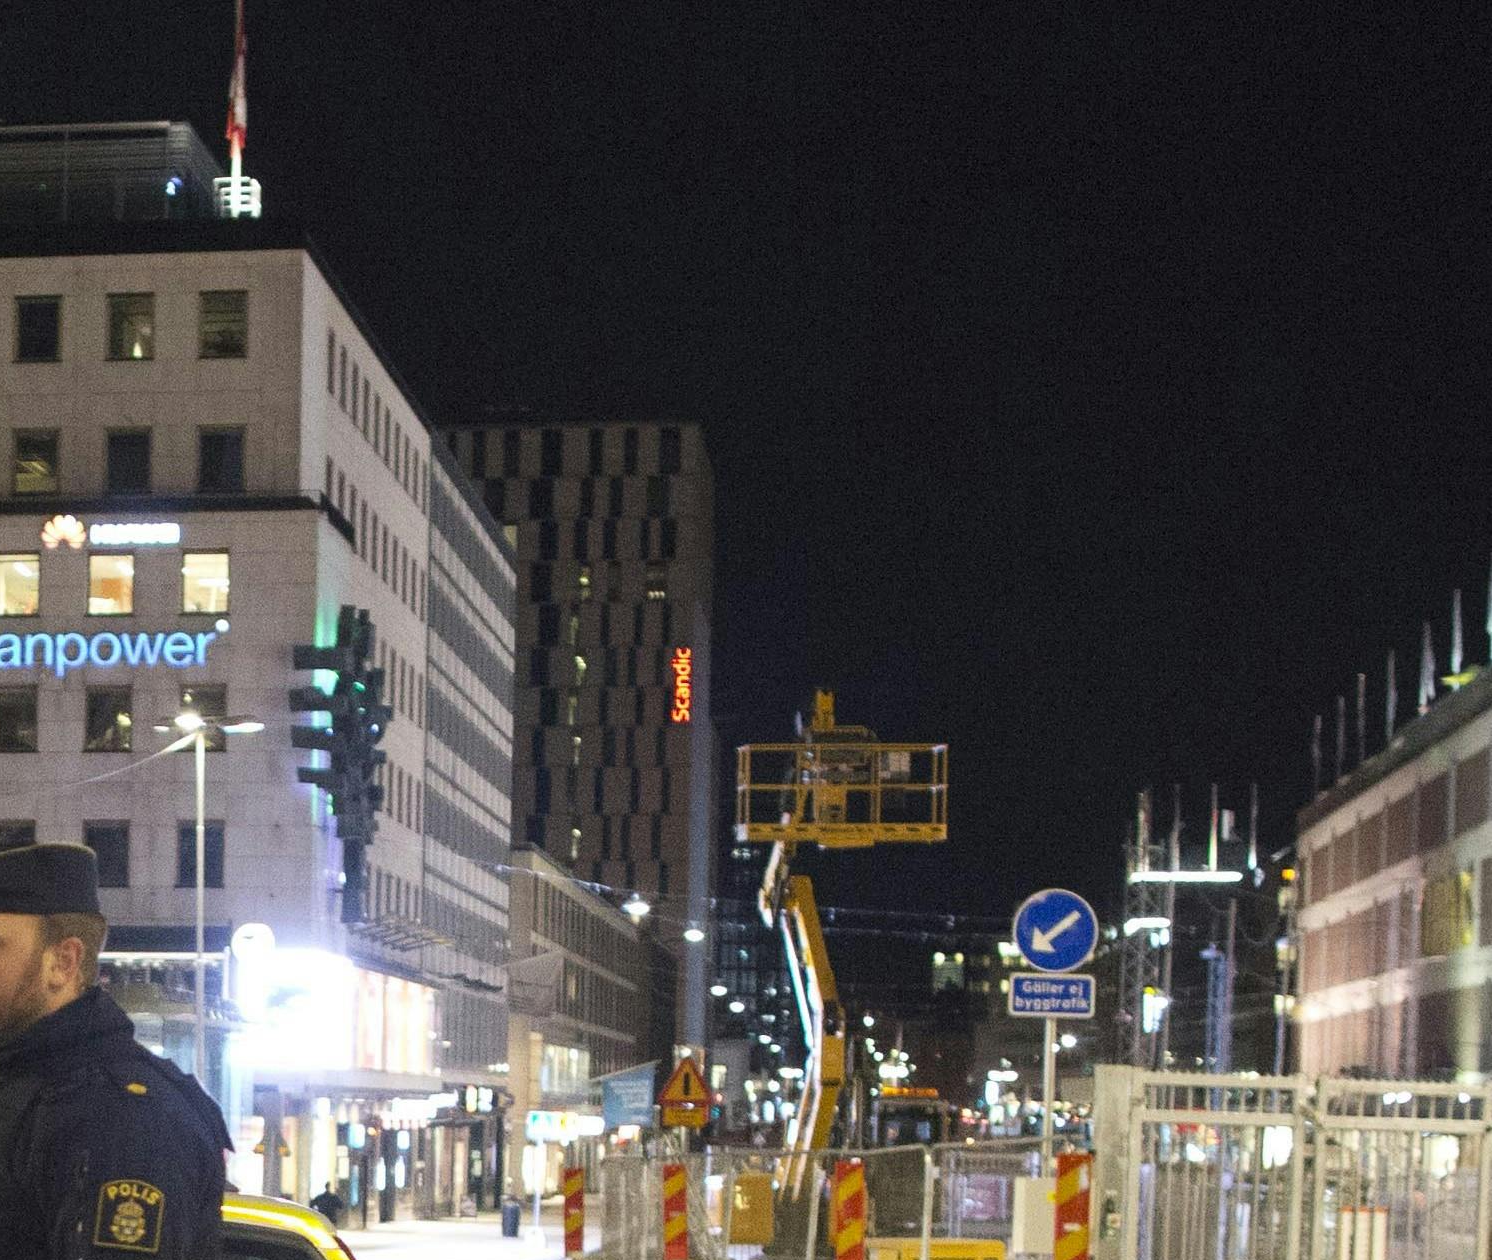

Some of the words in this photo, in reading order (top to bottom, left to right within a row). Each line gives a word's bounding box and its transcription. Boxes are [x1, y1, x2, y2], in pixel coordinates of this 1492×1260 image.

[671, 647, 692, 723] Scandic
[1022, 980, 1065, 994] Gäller
[1069, 981, 1084, 998] ej
[1014, 995, 1089, 1011] byggtrafik
[107, 1183, 160, 1206] POLIS
